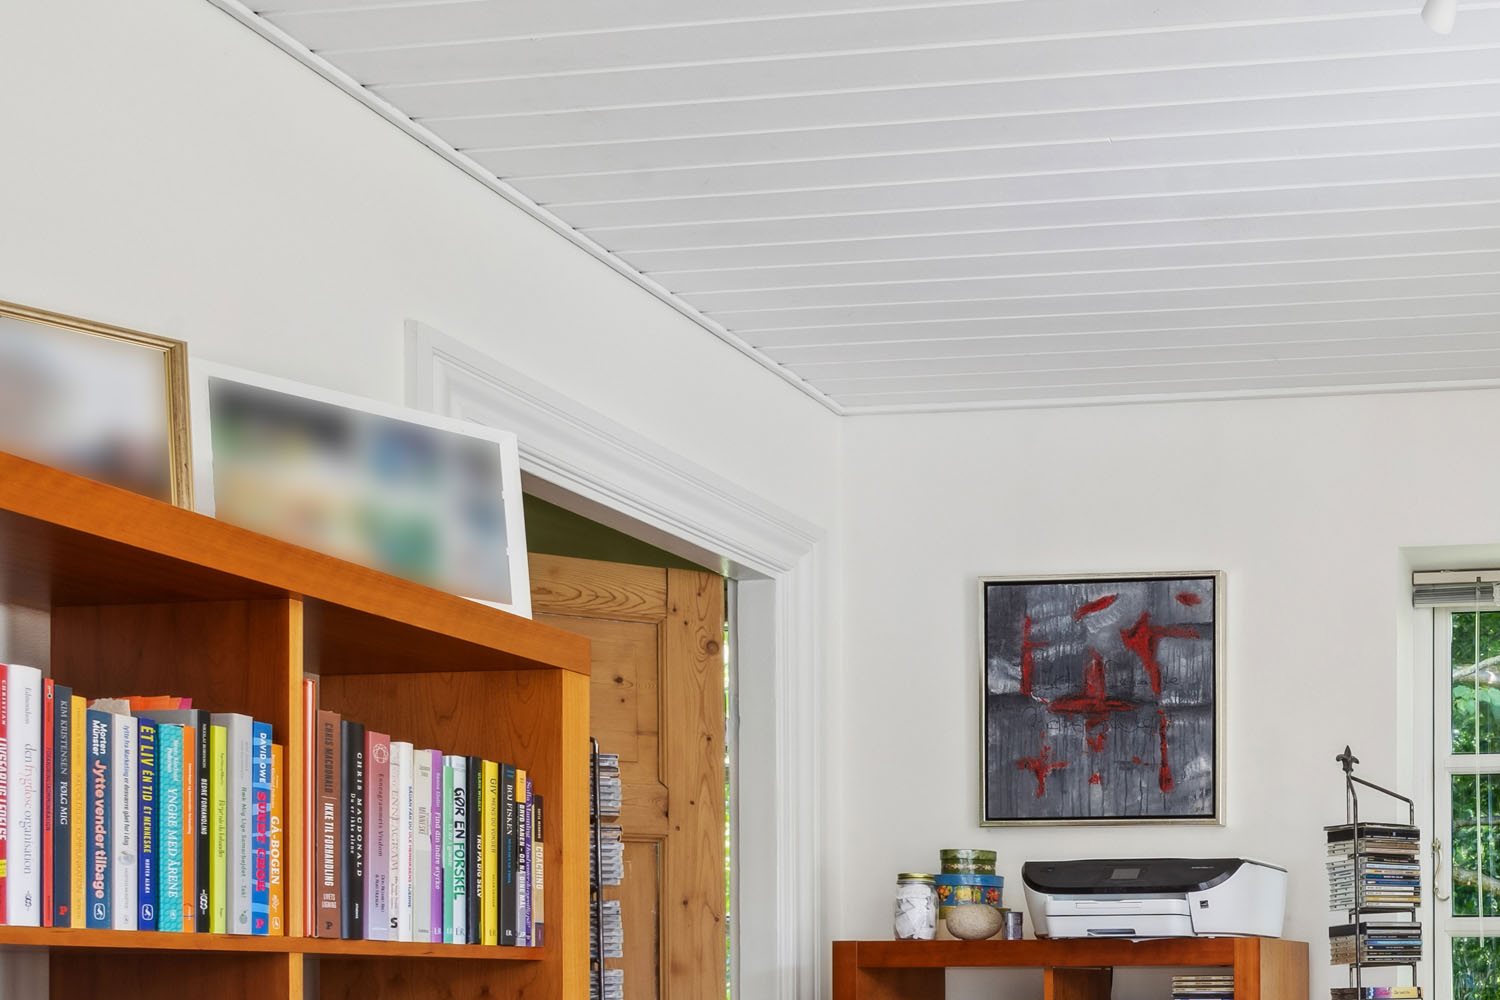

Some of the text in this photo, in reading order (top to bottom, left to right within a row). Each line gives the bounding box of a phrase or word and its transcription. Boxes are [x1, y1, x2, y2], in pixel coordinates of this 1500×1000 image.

[60, 700, 68, 825] KIM KRISTENSEN FØLG MIG
[92, 720, 101, 755] Münster
[99, 724, 107, 754] Morten
[259, 733, 267, 783] DAVID OWE
[324, 723, 333, 793] CHRIS MACDONALD
[93, 760, 106, 898] Jytte vender tilbage
[140, 726, 154, 853] ÉT LIV ÉN TID ÉT MENNESKE
[200, 778, 208, 834] BEDRE FORHANDLING
[167, 788, 180, 897] YNGRE MED ÅRENE
[256, 791, 266, 891] SUNDT CHOK
[271, 816, 281, 884] GÅ-BOGEN
[324, 803, 334, 886] IKKE TIL FORHANDLING
[454, 788, 465, 900] GØR EN FORSKEL
